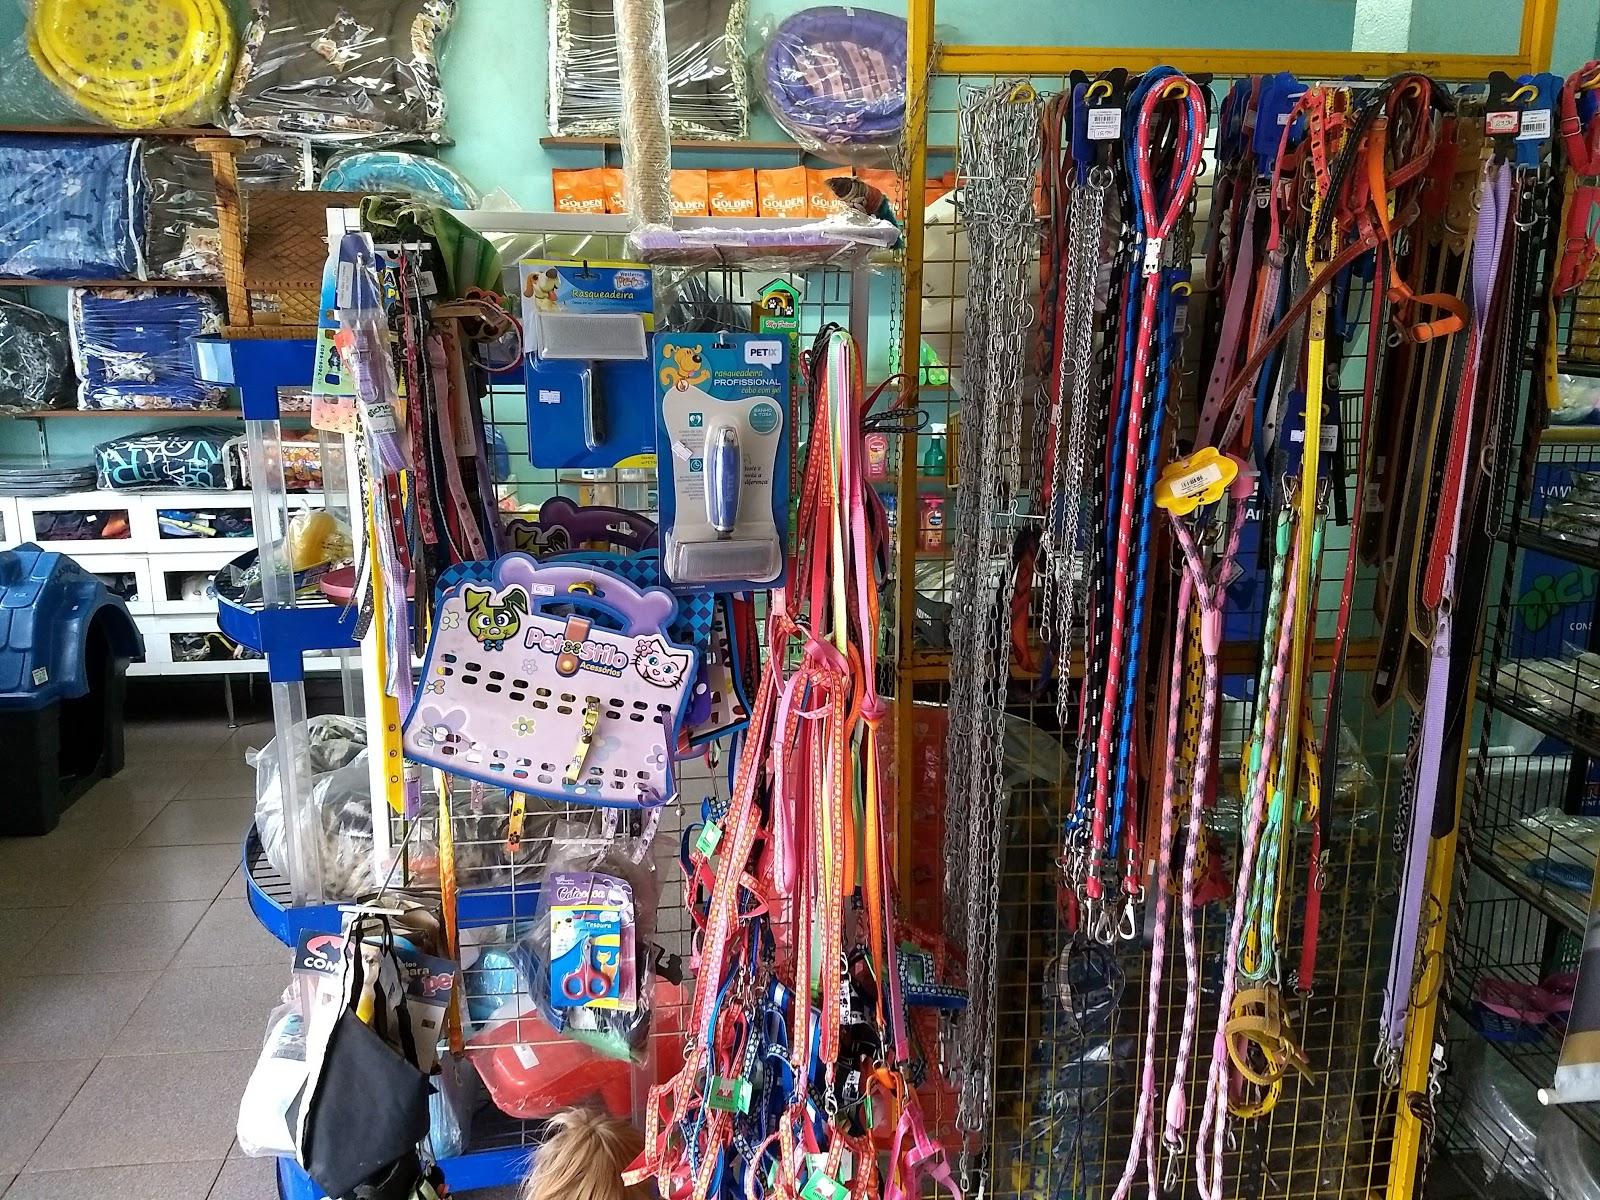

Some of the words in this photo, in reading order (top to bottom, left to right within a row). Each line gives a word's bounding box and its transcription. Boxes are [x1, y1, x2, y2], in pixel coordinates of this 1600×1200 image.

[559, 198, 603, 209] GOLDEN
[669, 200, 705, 209] OLDEN
[711, 197, 753, 209] GOLDEN
[763, 195, 804, 209] GOLDEN
[812, 194, 847, 209] GOLD
[572, 290, 635, 300] Rasqueadeira
[750, 348, 777, 357] PETIX
[714, 368, 763, 379] rasqueadeira
[713, 378, 781, 386] PROFISSIONAL
[525, 628, 565, 653] Pet
[580, 641, 628, 668] Stilo
[580, 661, 622, 678] Acessórios
[585, 921, 612, 929] Tesoura
